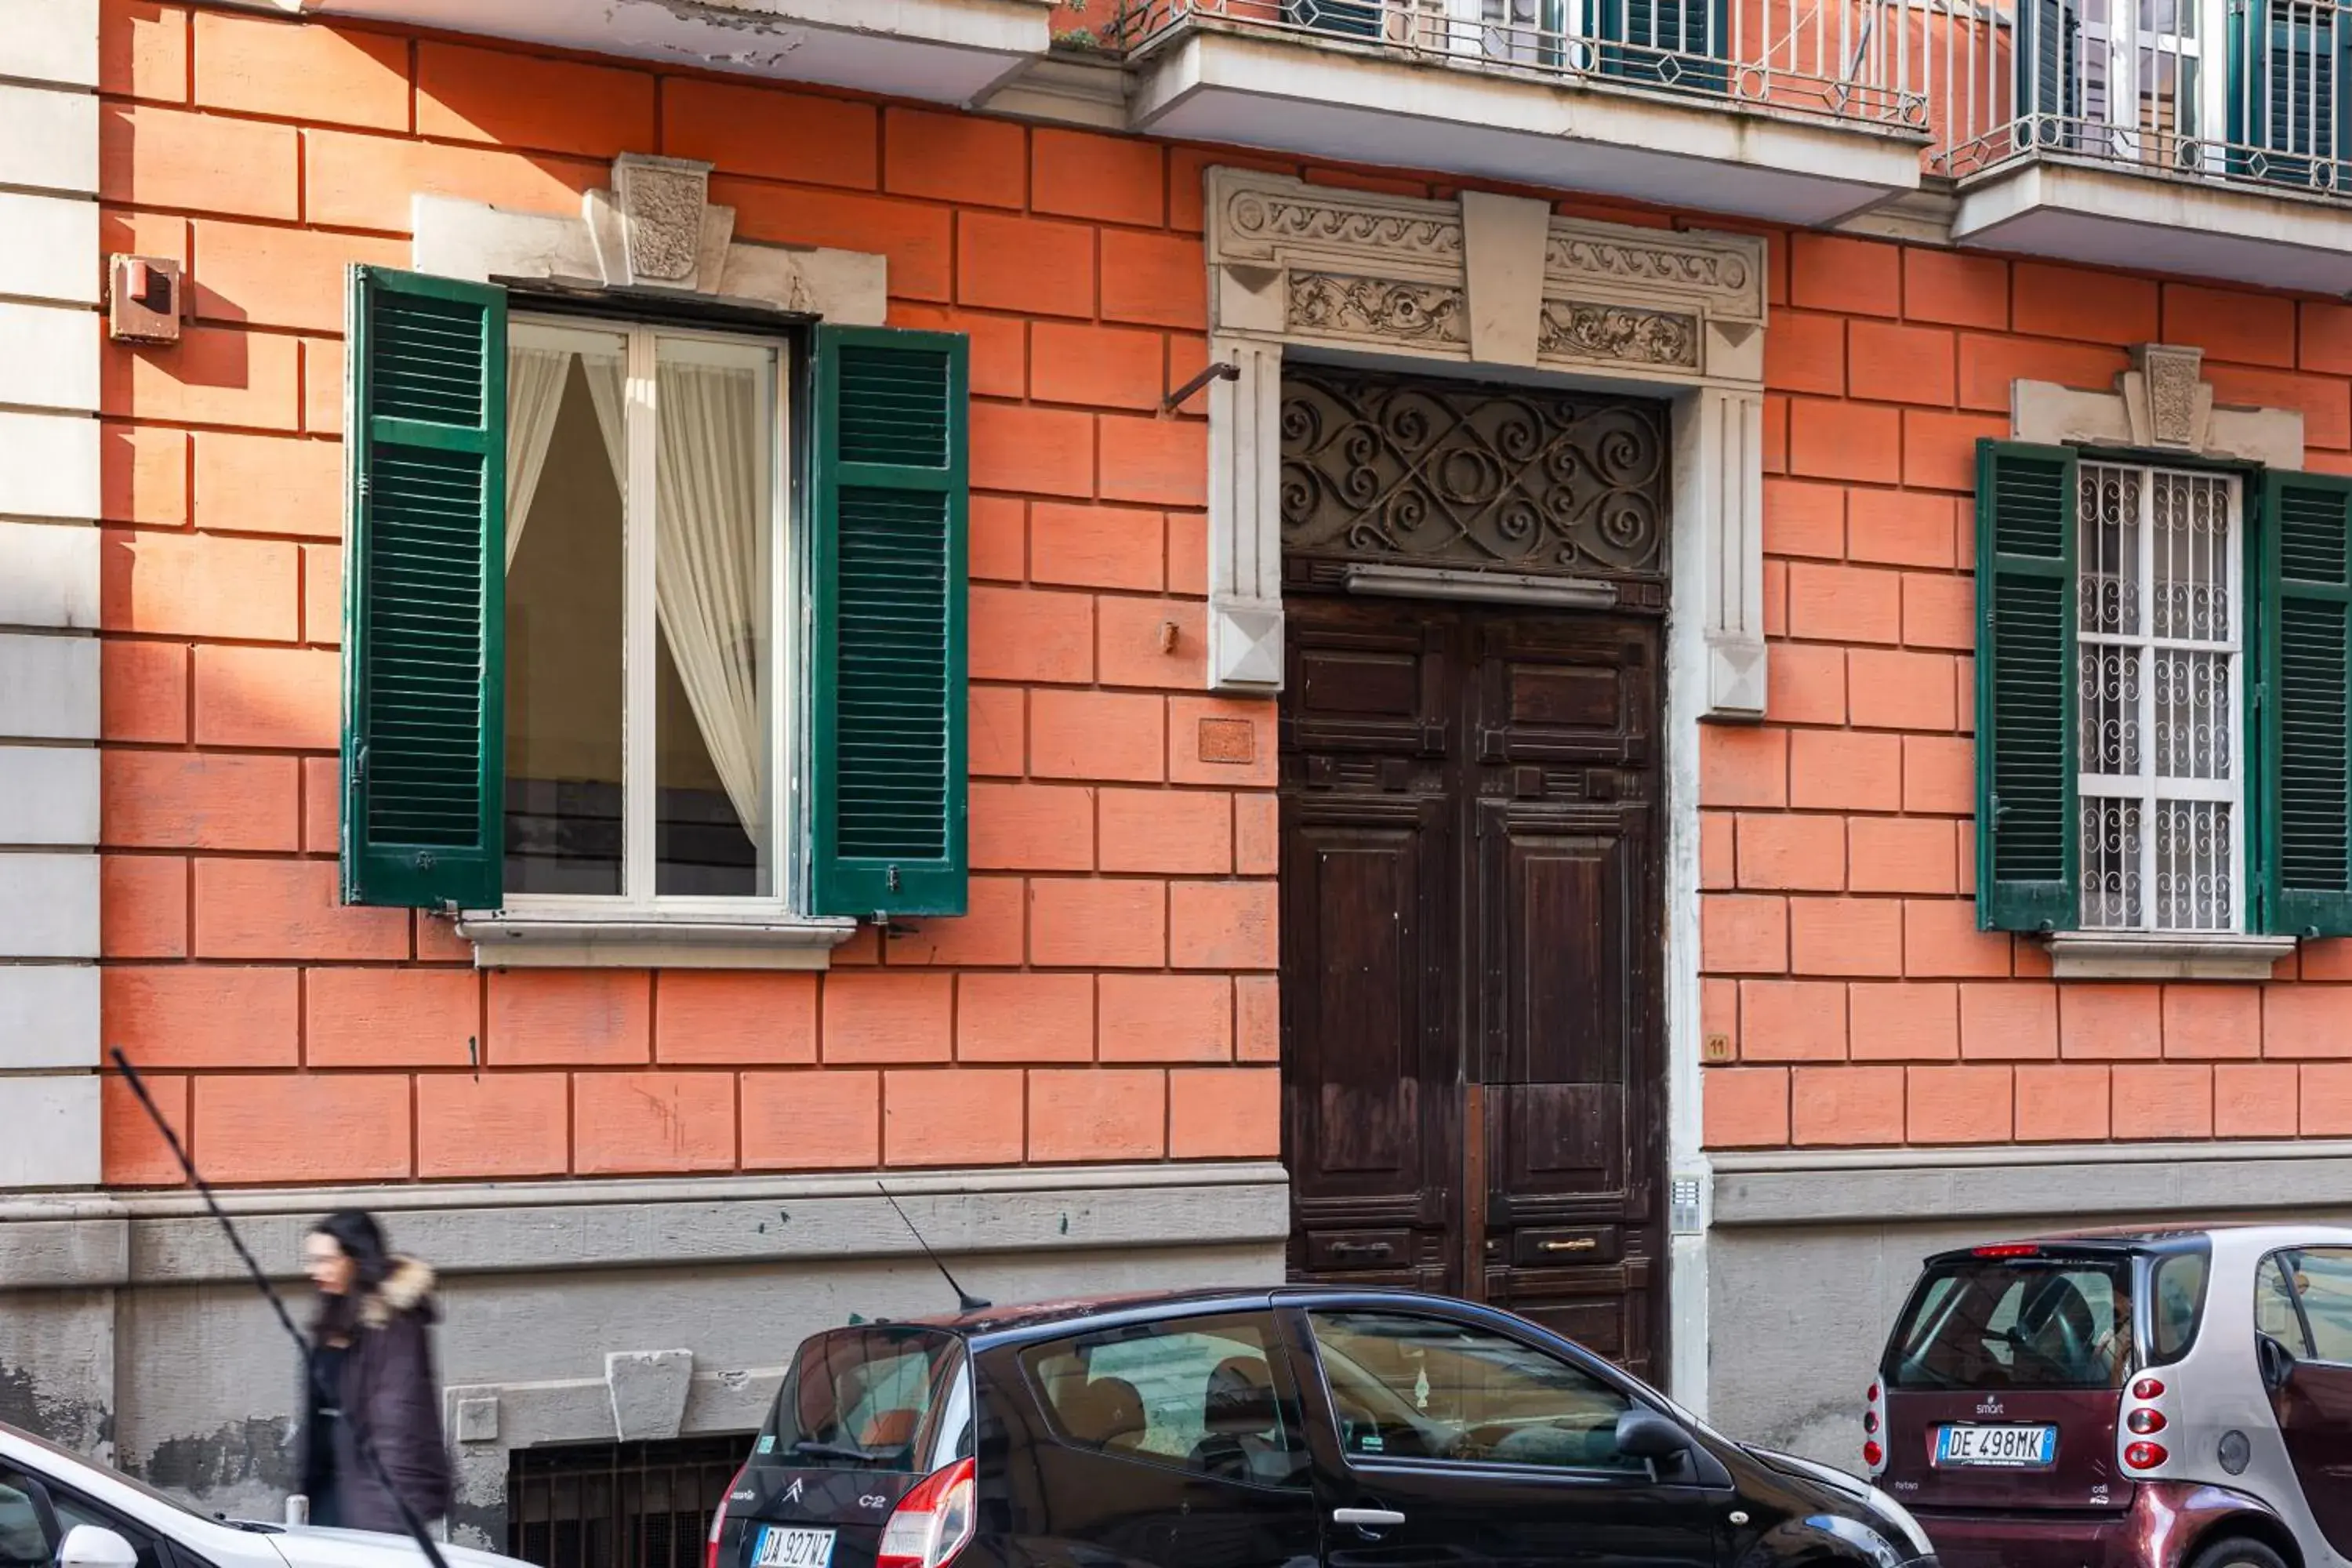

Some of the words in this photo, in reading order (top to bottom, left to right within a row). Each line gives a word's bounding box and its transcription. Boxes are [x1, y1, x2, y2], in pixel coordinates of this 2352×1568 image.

[1710, 1039, 1724, 1054] 11
[1976, 1404, 2004, 1414] smart
[1951, 1431, 1974, 1456] DE
[1980, 1431, 2042, 1457] 498MK
[858, 1494, 887, 1508] C2
[762, 1530, 782, 1563] DA
